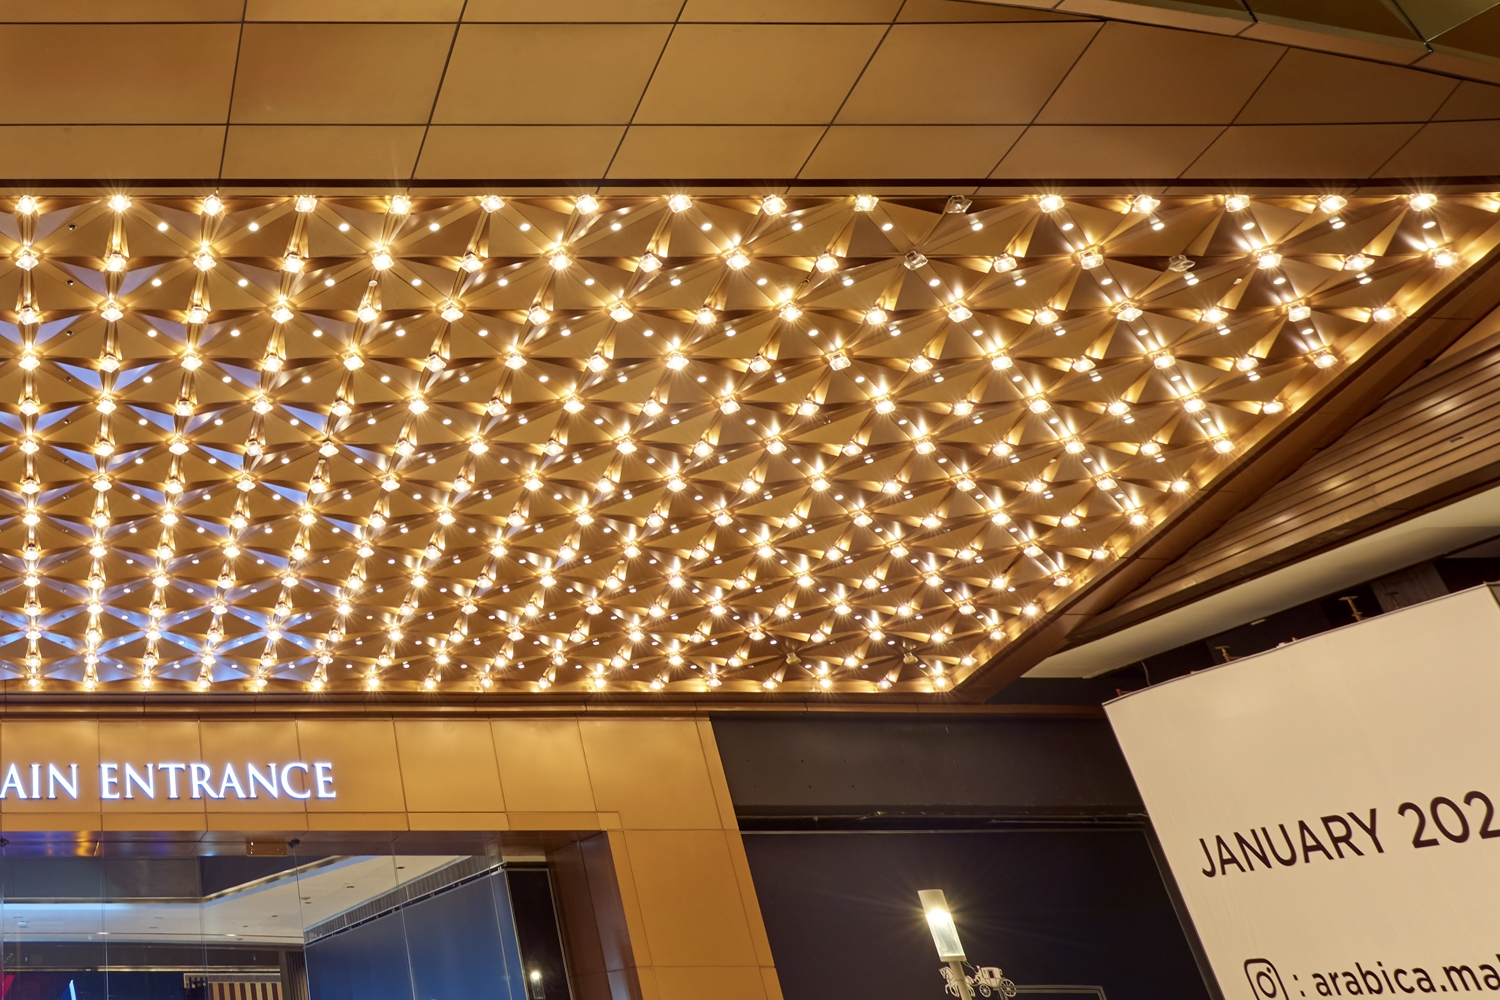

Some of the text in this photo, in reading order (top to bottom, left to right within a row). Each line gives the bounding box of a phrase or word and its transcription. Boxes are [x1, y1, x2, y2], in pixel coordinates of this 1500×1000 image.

[100, 761, 337, 800] ENTRANCE
[1198, 807, 1385, 878] JANUARY
[1311, 953, 1500, 997] arabica.ma
